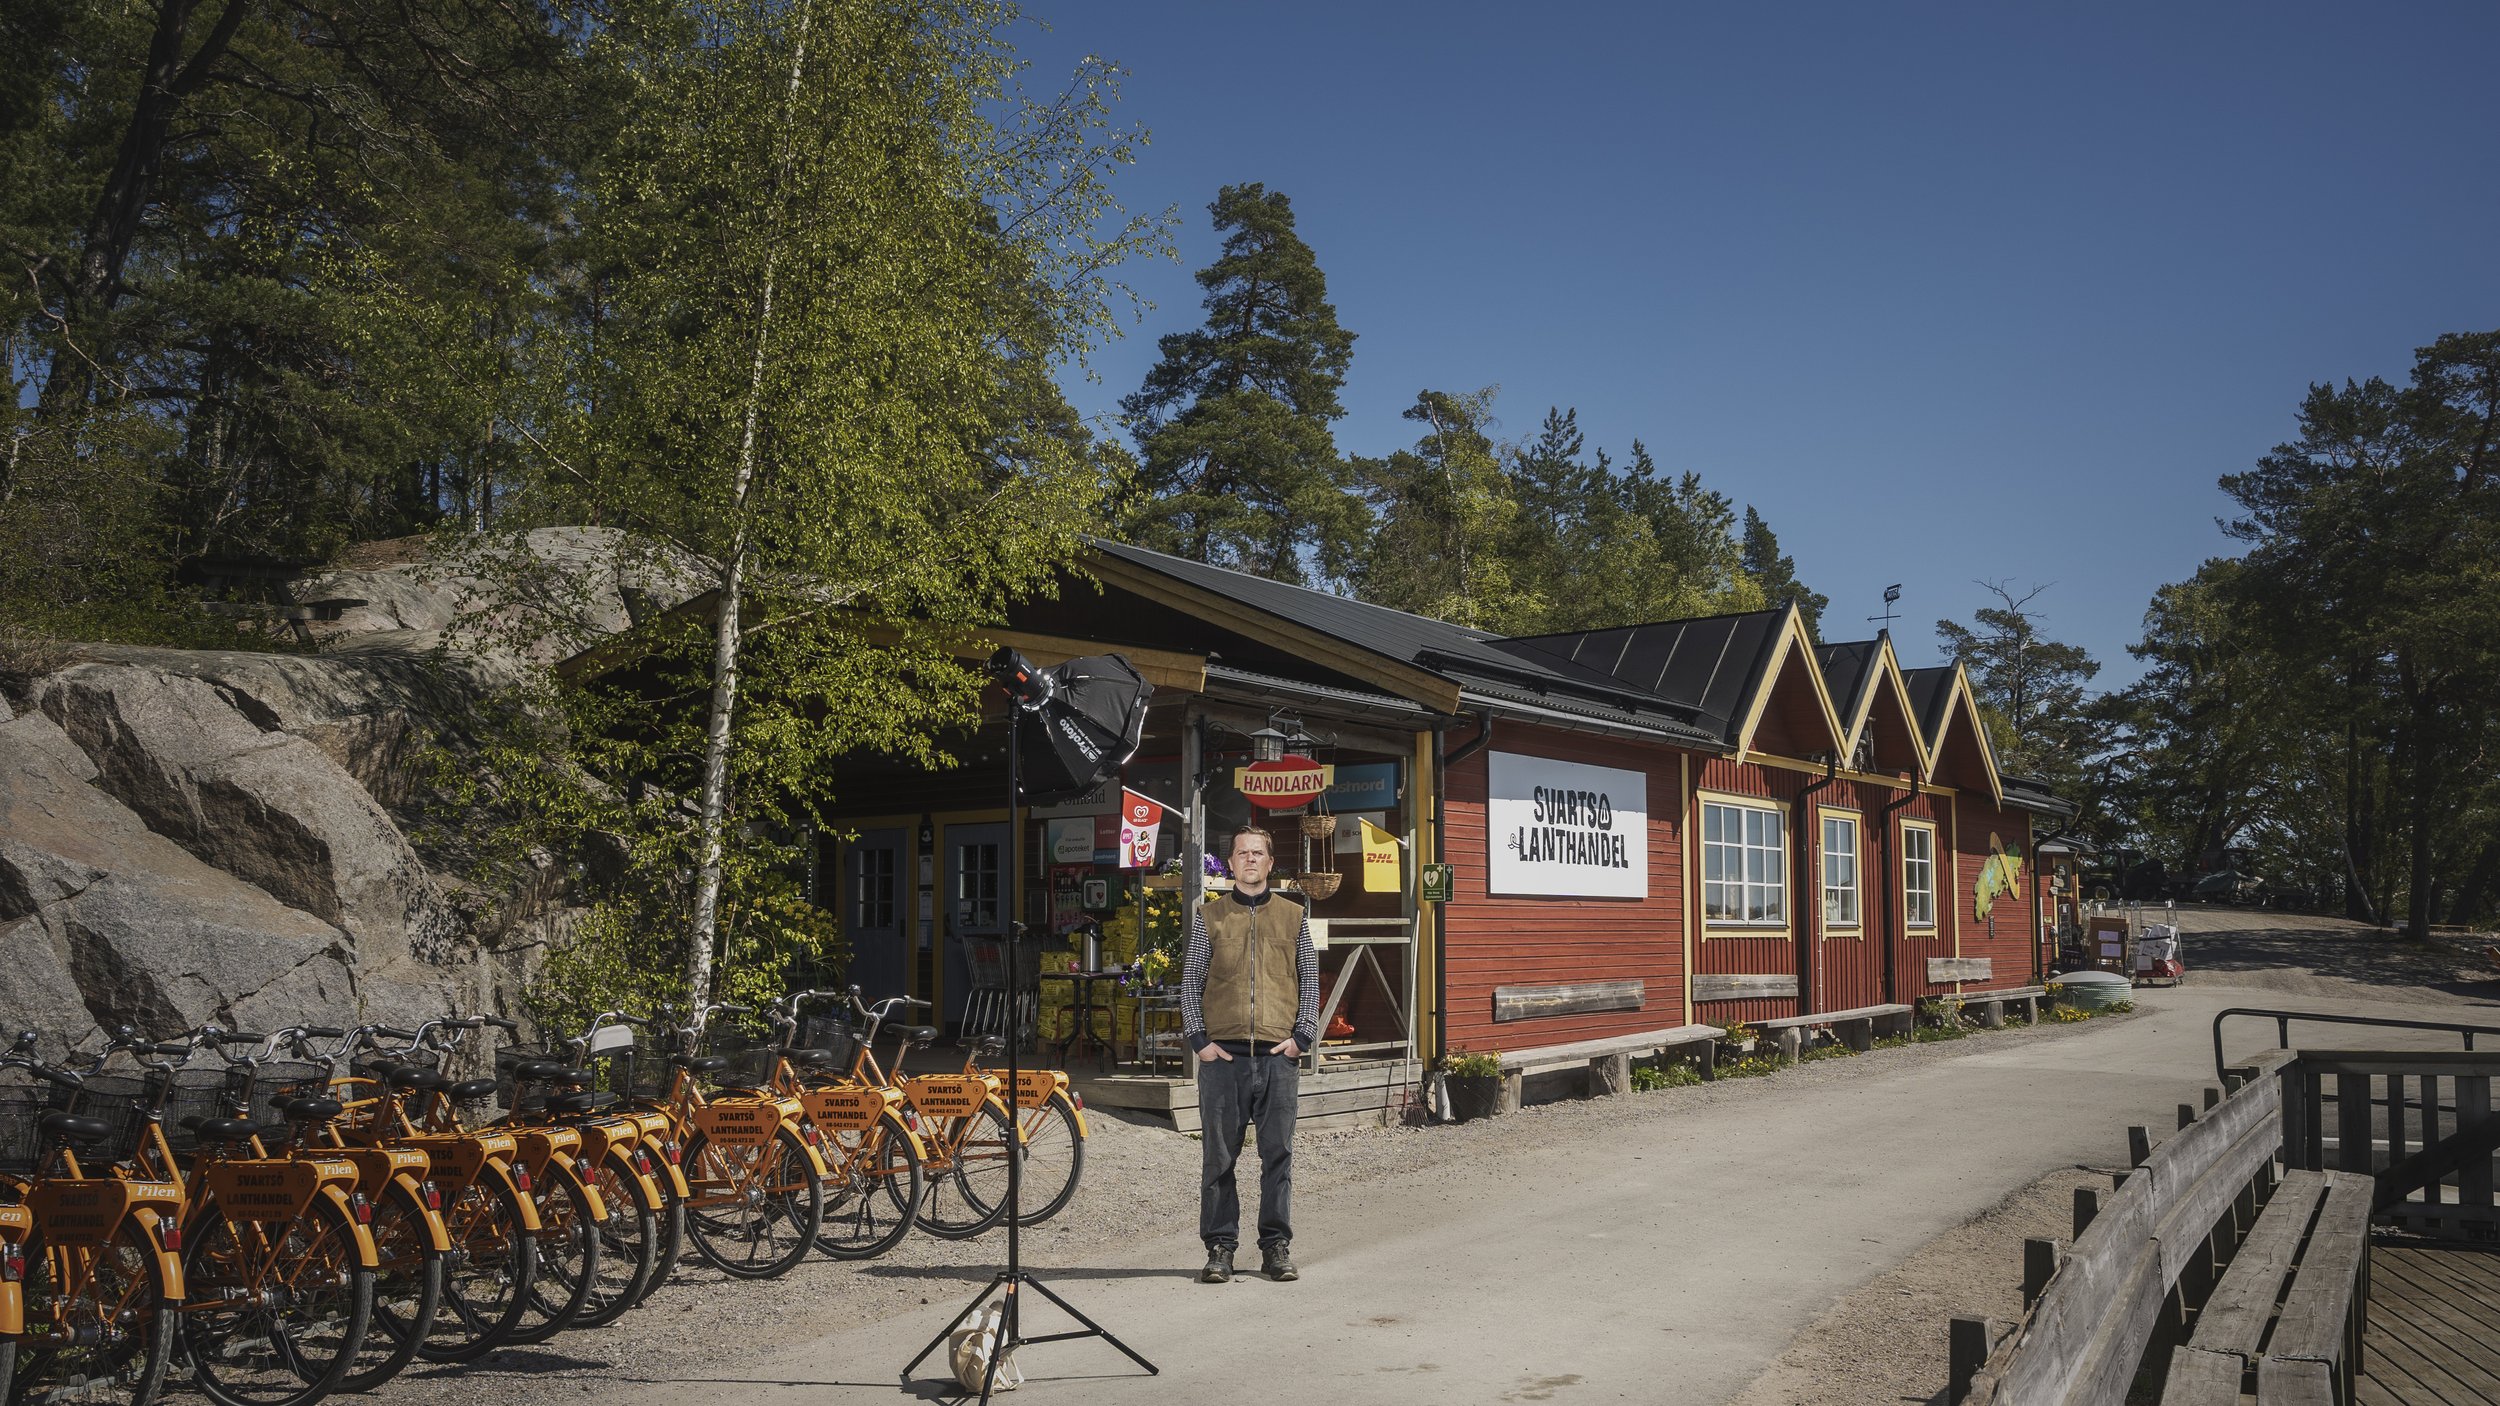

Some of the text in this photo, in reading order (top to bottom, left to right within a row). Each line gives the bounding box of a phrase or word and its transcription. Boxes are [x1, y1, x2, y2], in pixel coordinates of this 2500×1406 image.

[1059, 718, 1090, 754] Profoto
[1064, 845, 1089, 853] apoteket
[1519, 826, 1628, 869] LANTHANDEL
[1366, 853, 1393, 863] DHL
[1000, 1076, 1032, 1086] SVTSÖ
[927, 1083, 963, 1094] SVARTSÖ
[825, 1097, 860, 1107] SVARTSÖ
[920, 1097, 971, 1107] LANTHANDEL
[718, 1111, 755, 1121] SVARTSÖ
[817, 1111, 868, 1120] LANTHANDEL
[645, 1118, 664, 1128] Pilen
[611, 1126, 632, 1138] Pilen
[710, 1126, 764, 1135] LANTHANDEL
[487, 1138, 511, 1149] Pilen
[554, 1132, 576, 1144] Pilen
[397, 1153, 423, 1164] Pilen
[323, 1164, 352, 1175] Pilen
[236, 1171, 284, 1187] SVARTSÖ
[137, 1186, 176, 1198] Pilen
[226, 1193, 293, 1206] LANTHANDEL
